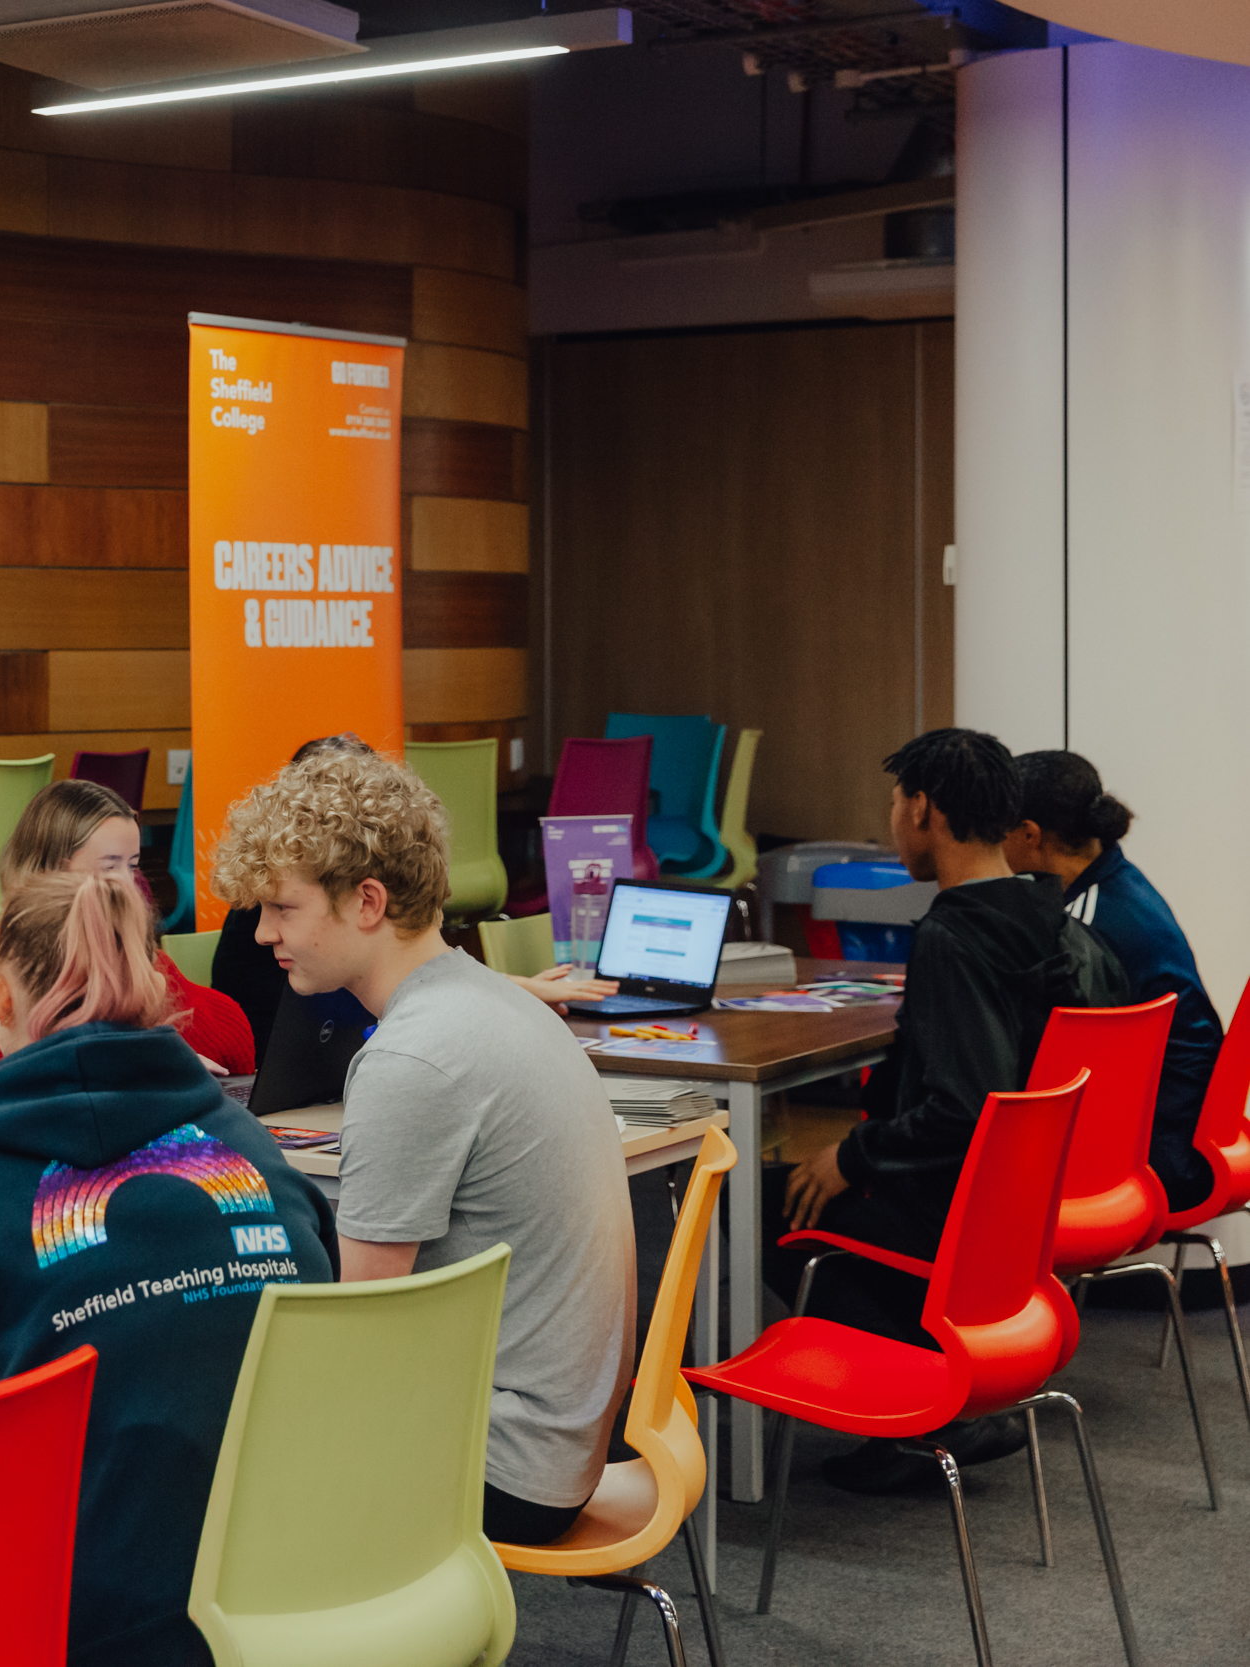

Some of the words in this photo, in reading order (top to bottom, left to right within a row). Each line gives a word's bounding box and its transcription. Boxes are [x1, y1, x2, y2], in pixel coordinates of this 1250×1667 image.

[209, 348, 237, 371] The
[210, 377, 272, 403] Sheffield
[210, 405, 265, 435] College
[213, 540, 314, 591] CAREERS
[317, 544, 394, 593] ADVICE
[244, 597, 262, 648] &
[264, 599, 374, 648] GUIDANCE
[235, 1225, 287, 1252] NHS
[51, 1284, 136, 1332] Sheffield
[137, 1266, 225, 1299] Teaching
[228, 1257, 298, 1281] Hospitals
[182, 1287, 210, 1305] NHS
[212, 1278, 277, 1298] Foundati
